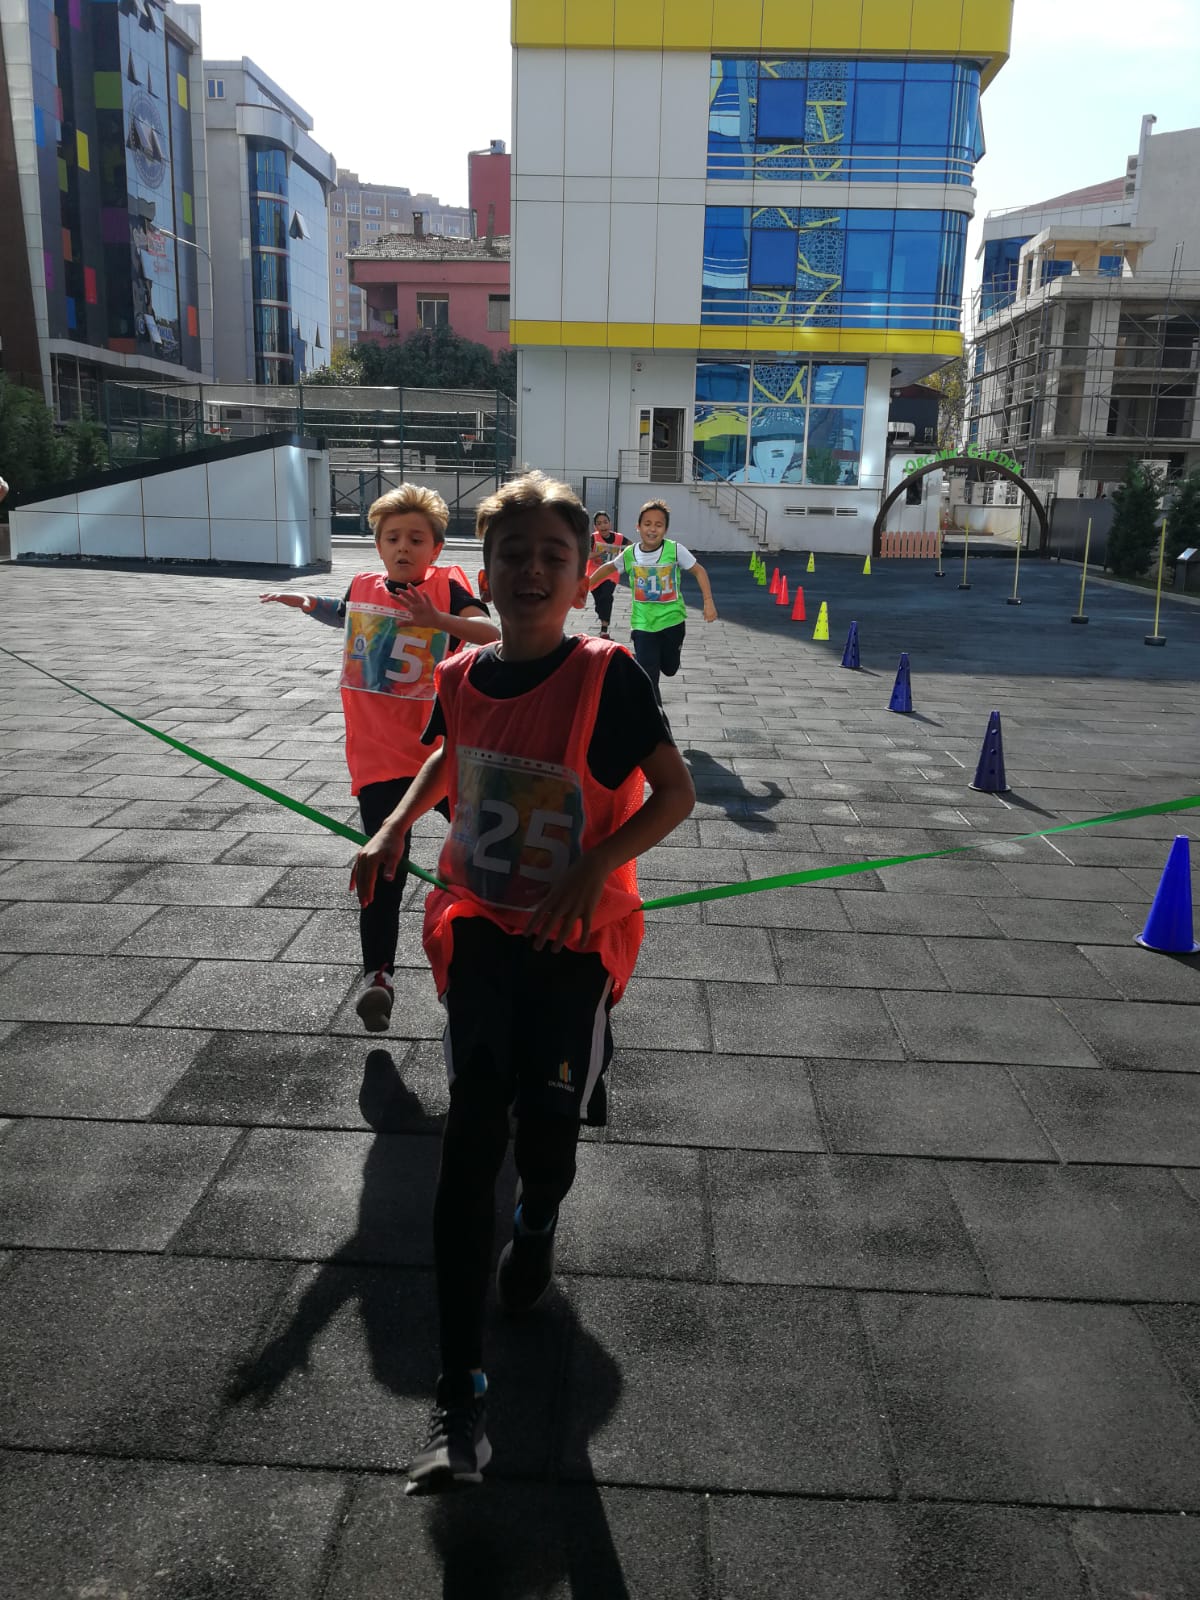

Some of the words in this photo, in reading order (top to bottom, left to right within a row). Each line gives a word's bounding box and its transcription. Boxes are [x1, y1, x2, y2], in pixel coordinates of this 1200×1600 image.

[967, 442, 1023, 475] GARDEN
[648, 575, 672, 594] 11
[385, 634, 427, 683] 5
[472, 799, 573, 883] 25
